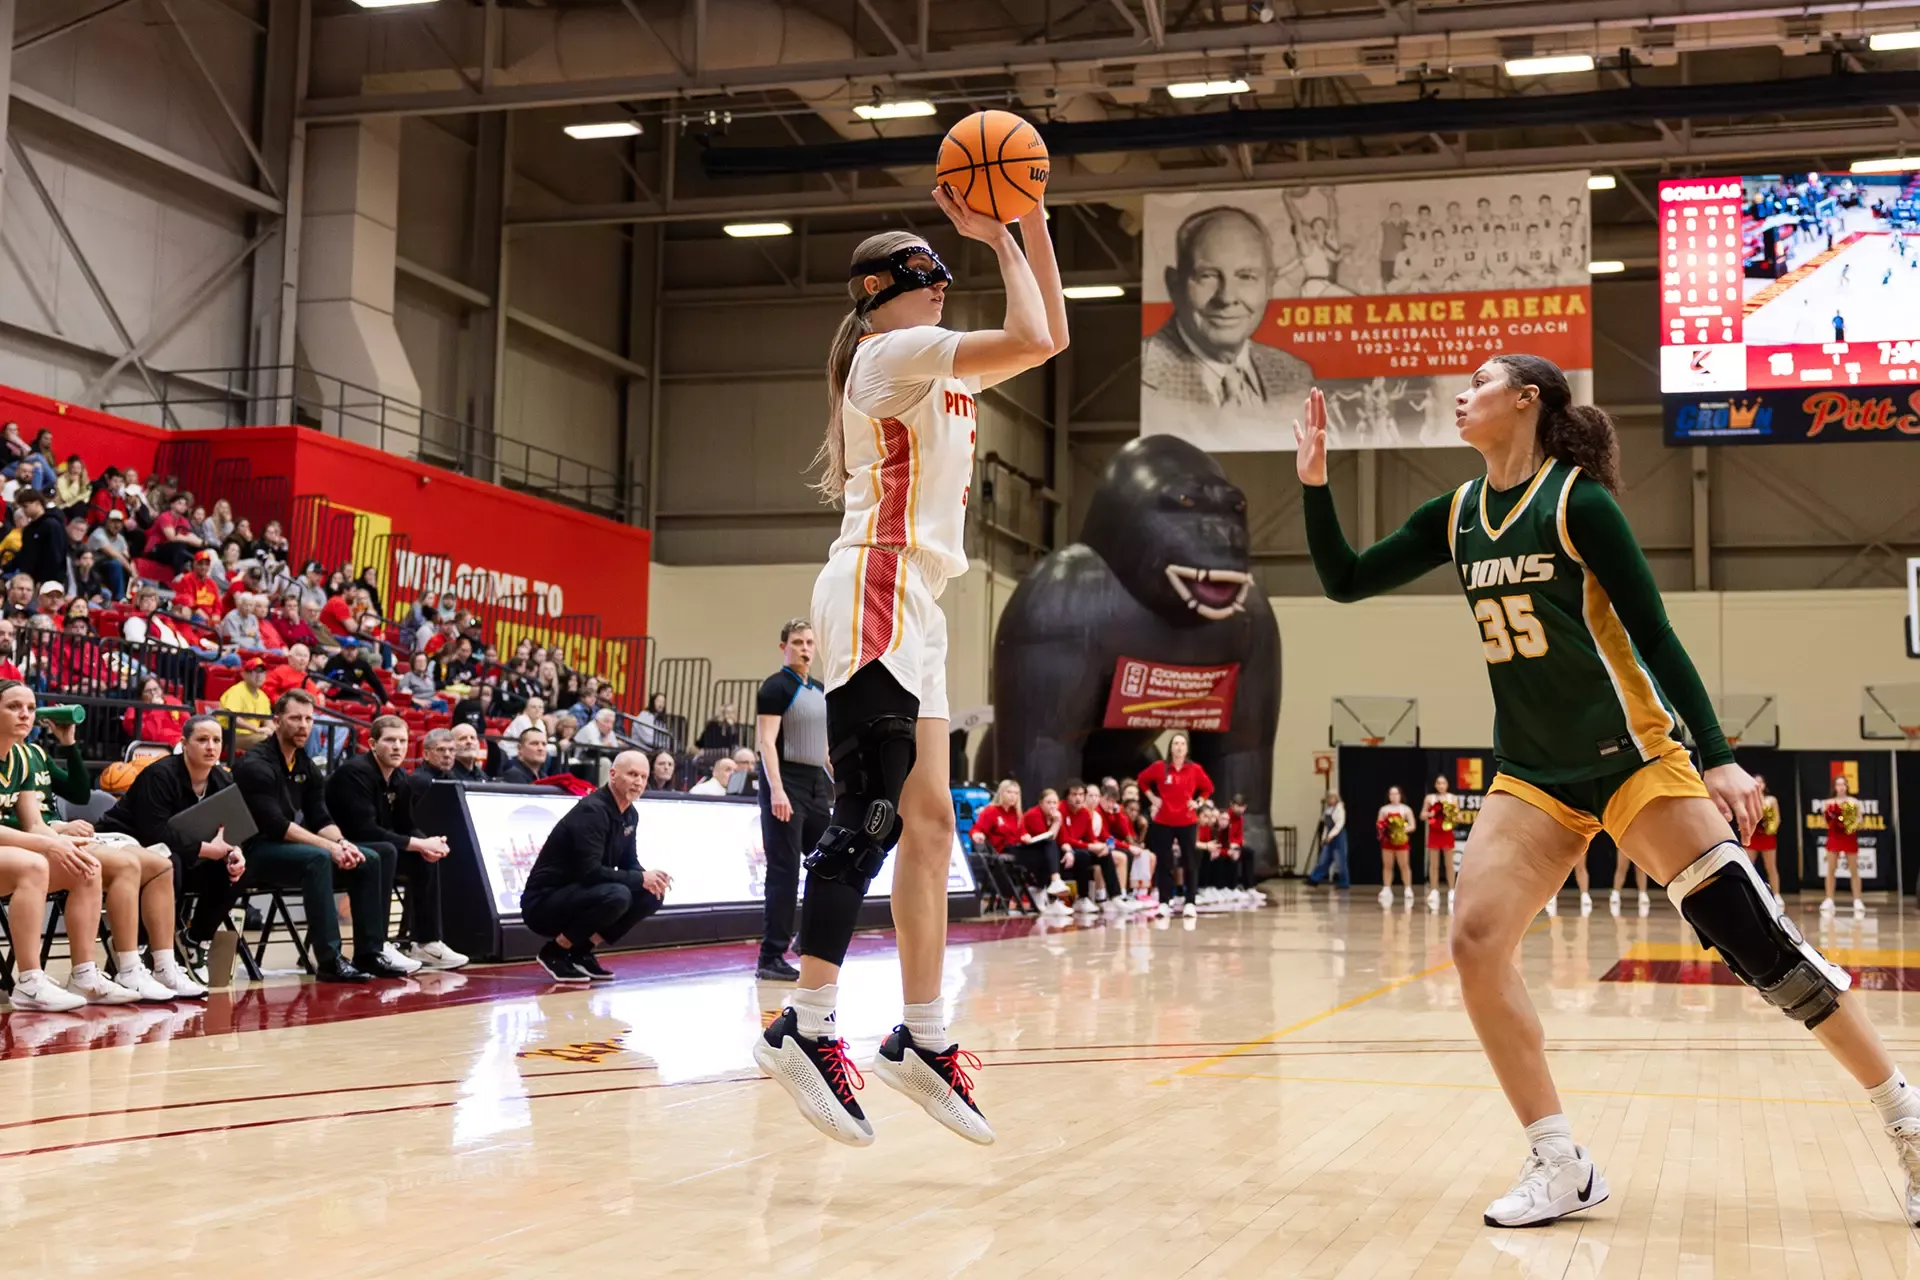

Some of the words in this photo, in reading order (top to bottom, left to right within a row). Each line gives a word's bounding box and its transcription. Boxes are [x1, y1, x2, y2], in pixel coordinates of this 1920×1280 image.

[1661, 183, 1741, 202] GORILLAS
[1277, 304, 1354, 327] JOHN
[1366, 300, 1465, 324] LANCE
[1478, 294, 1586, 320] ARENA
[1292, 330, 1343, 344] MEN'S
[1350, 327, 1447, 342] BASKETBALL
[1455, 323, 1500, 338] HEAD
[1507, 320, 1569, 336] COACH
[1437, 338, 1504, 352] 1936-63
[1426, 353, 1469, 366] WINS
[1802, 390, 1897, 438] Pitt
[395, 548, 528, 612] WELCOME
[533, 579, 563, 618] TO
[1474, 593, 1549, 664] 35
[1150, 676, 1214, 690] NATIONAL
[1152, 667, 1229, 681] COMMUNITY
